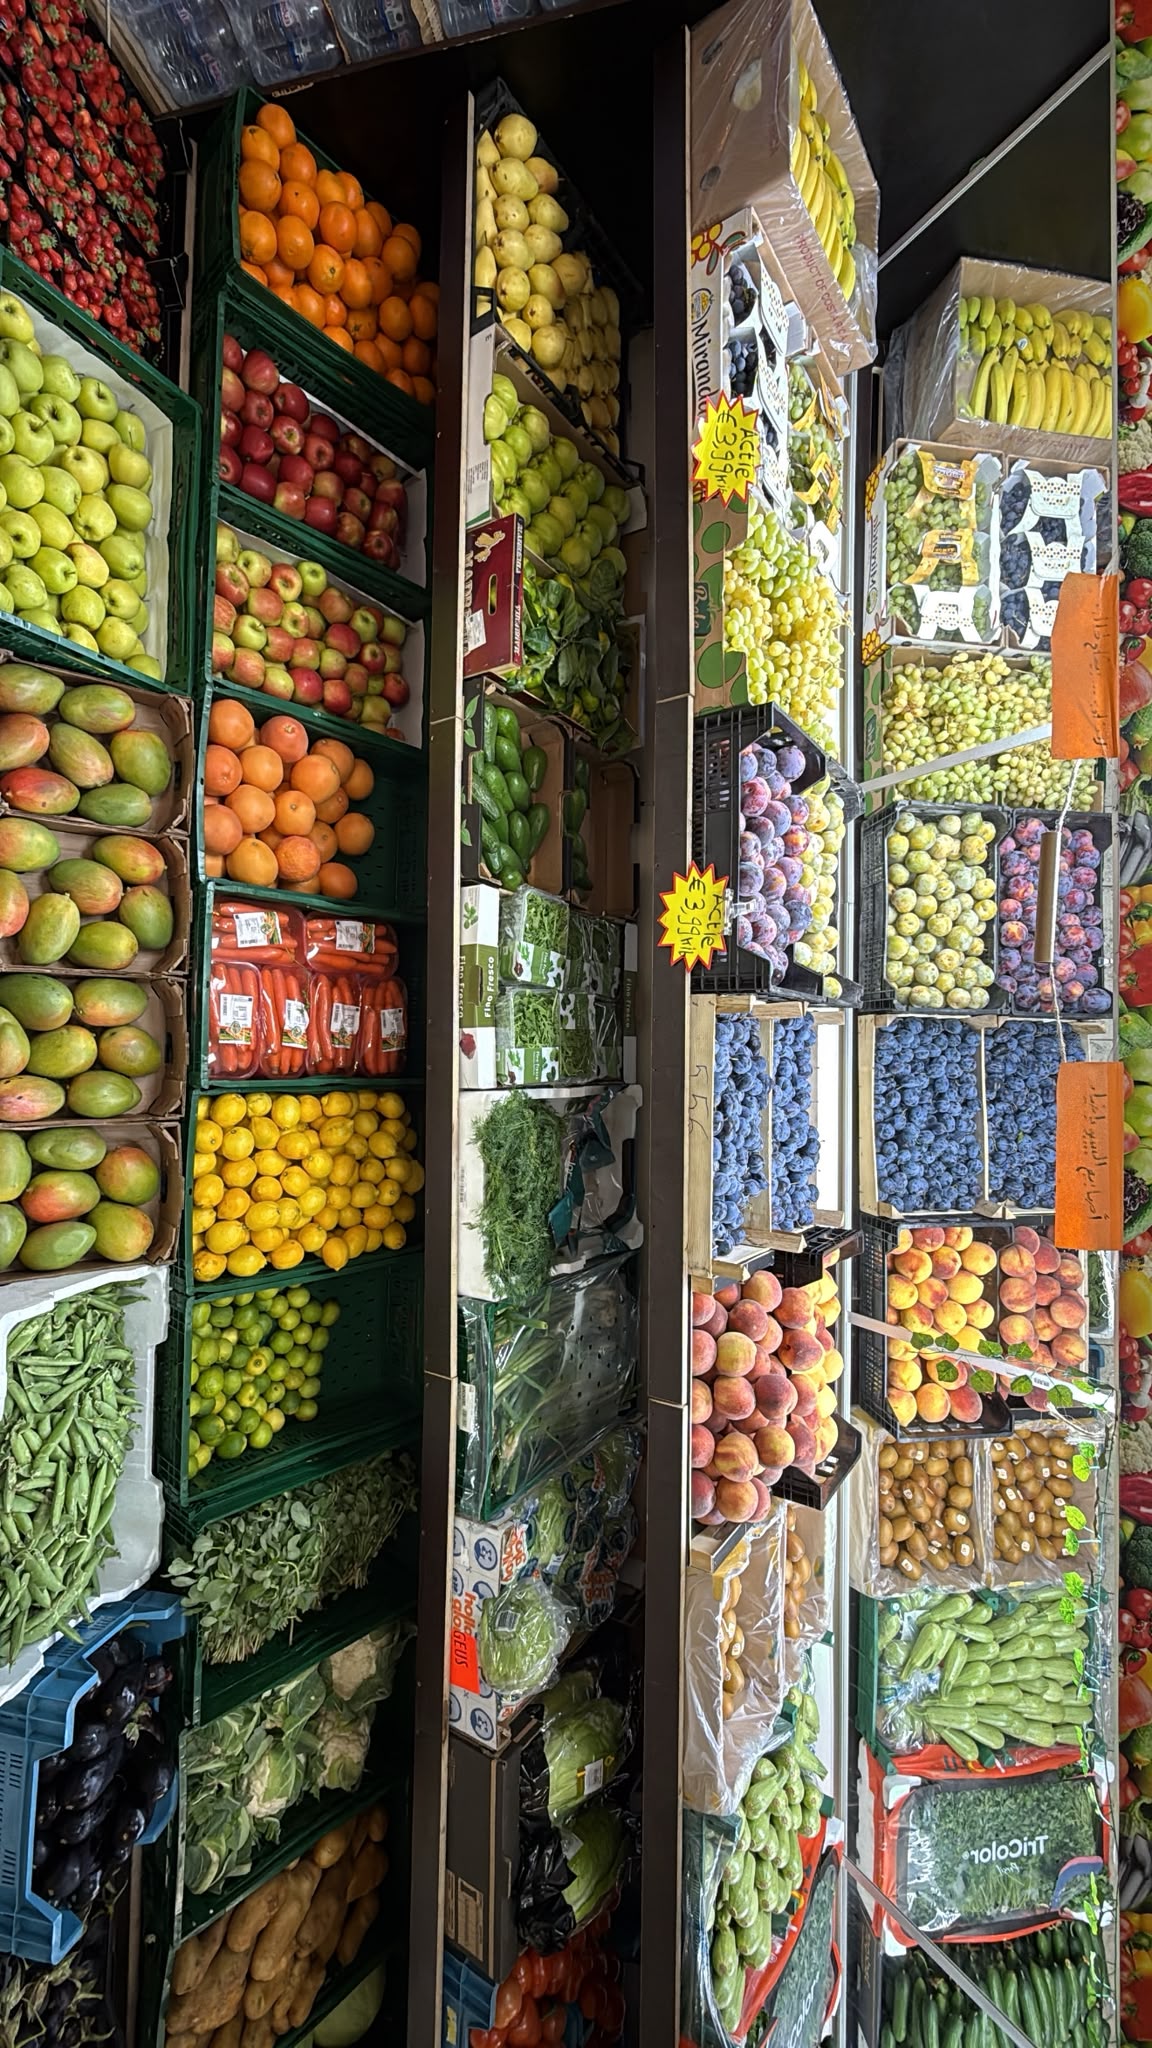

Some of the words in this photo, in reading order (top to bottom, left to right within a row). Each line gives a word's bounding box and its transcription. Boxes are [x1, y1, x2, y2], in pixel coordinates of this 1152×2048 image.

[794, 233, 821, 278] PRODUCT
[816, 280, 828, 292] OF
[486, 956, 494, 992] Fresco
[484, 996, 493, 1018] Fino
[453, 1630, 468, 1668] GEUS
